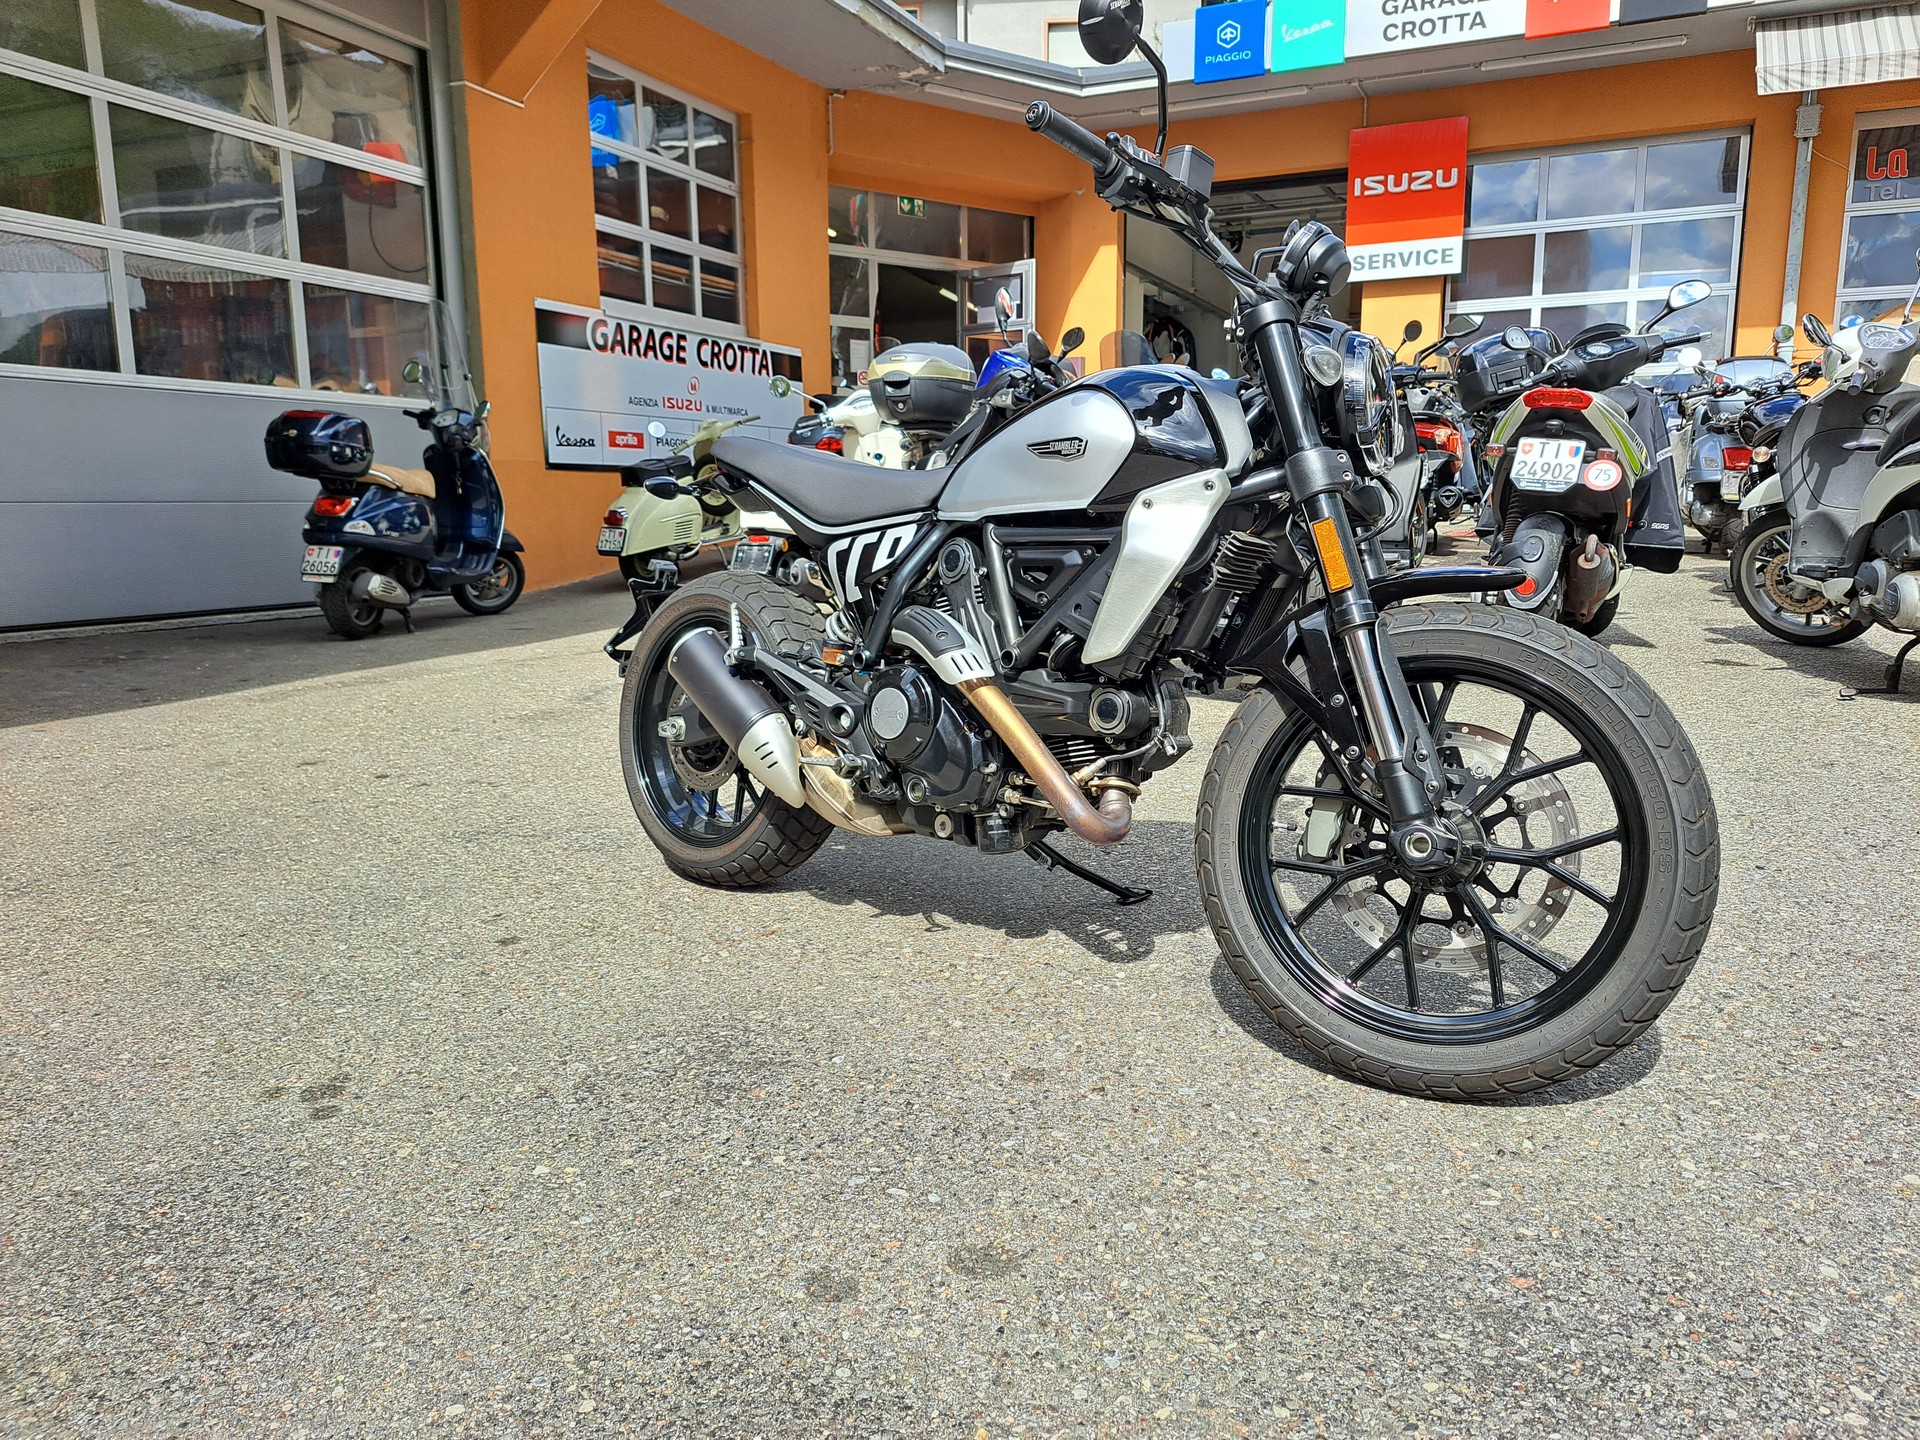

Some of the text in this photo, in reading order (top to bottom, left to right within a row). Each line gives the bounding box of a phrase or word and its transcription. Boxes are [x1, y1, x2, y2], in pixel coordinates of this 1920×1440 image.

[1281, 19, 1335, 43] Vespa
[1383, 11, 1487, 42] CROTTA
[1205, 50, 1252, 65] PIAGGIO
[1866, 146, 1909, 180] La
[1354, 167, 1459, 197] ISUZU
[1864, 181, 1909, 200] Tel.
[1352, 248, 1454, 272] SERVICE
[592, 318, 773, 378] GARAGE CROTTA
[628, 396, 749, 417] AGENZIA ISUZU & MULTIMARCA
[555, 425, 596, 447] Vespa
[614, 433, 639, 446] aprilia
[1049, 440, 1080, 451] SCRAMBLER
[1539, 441, 1562, 460] TI
[1514, 460, 1577, 481] 24902
[1594, 468, 1613, 482] 75
[316, 547, 331, 559] TI
[303, 560, 337, 573] 26056
[1517, 649, 1629, 733] PIRELLI
